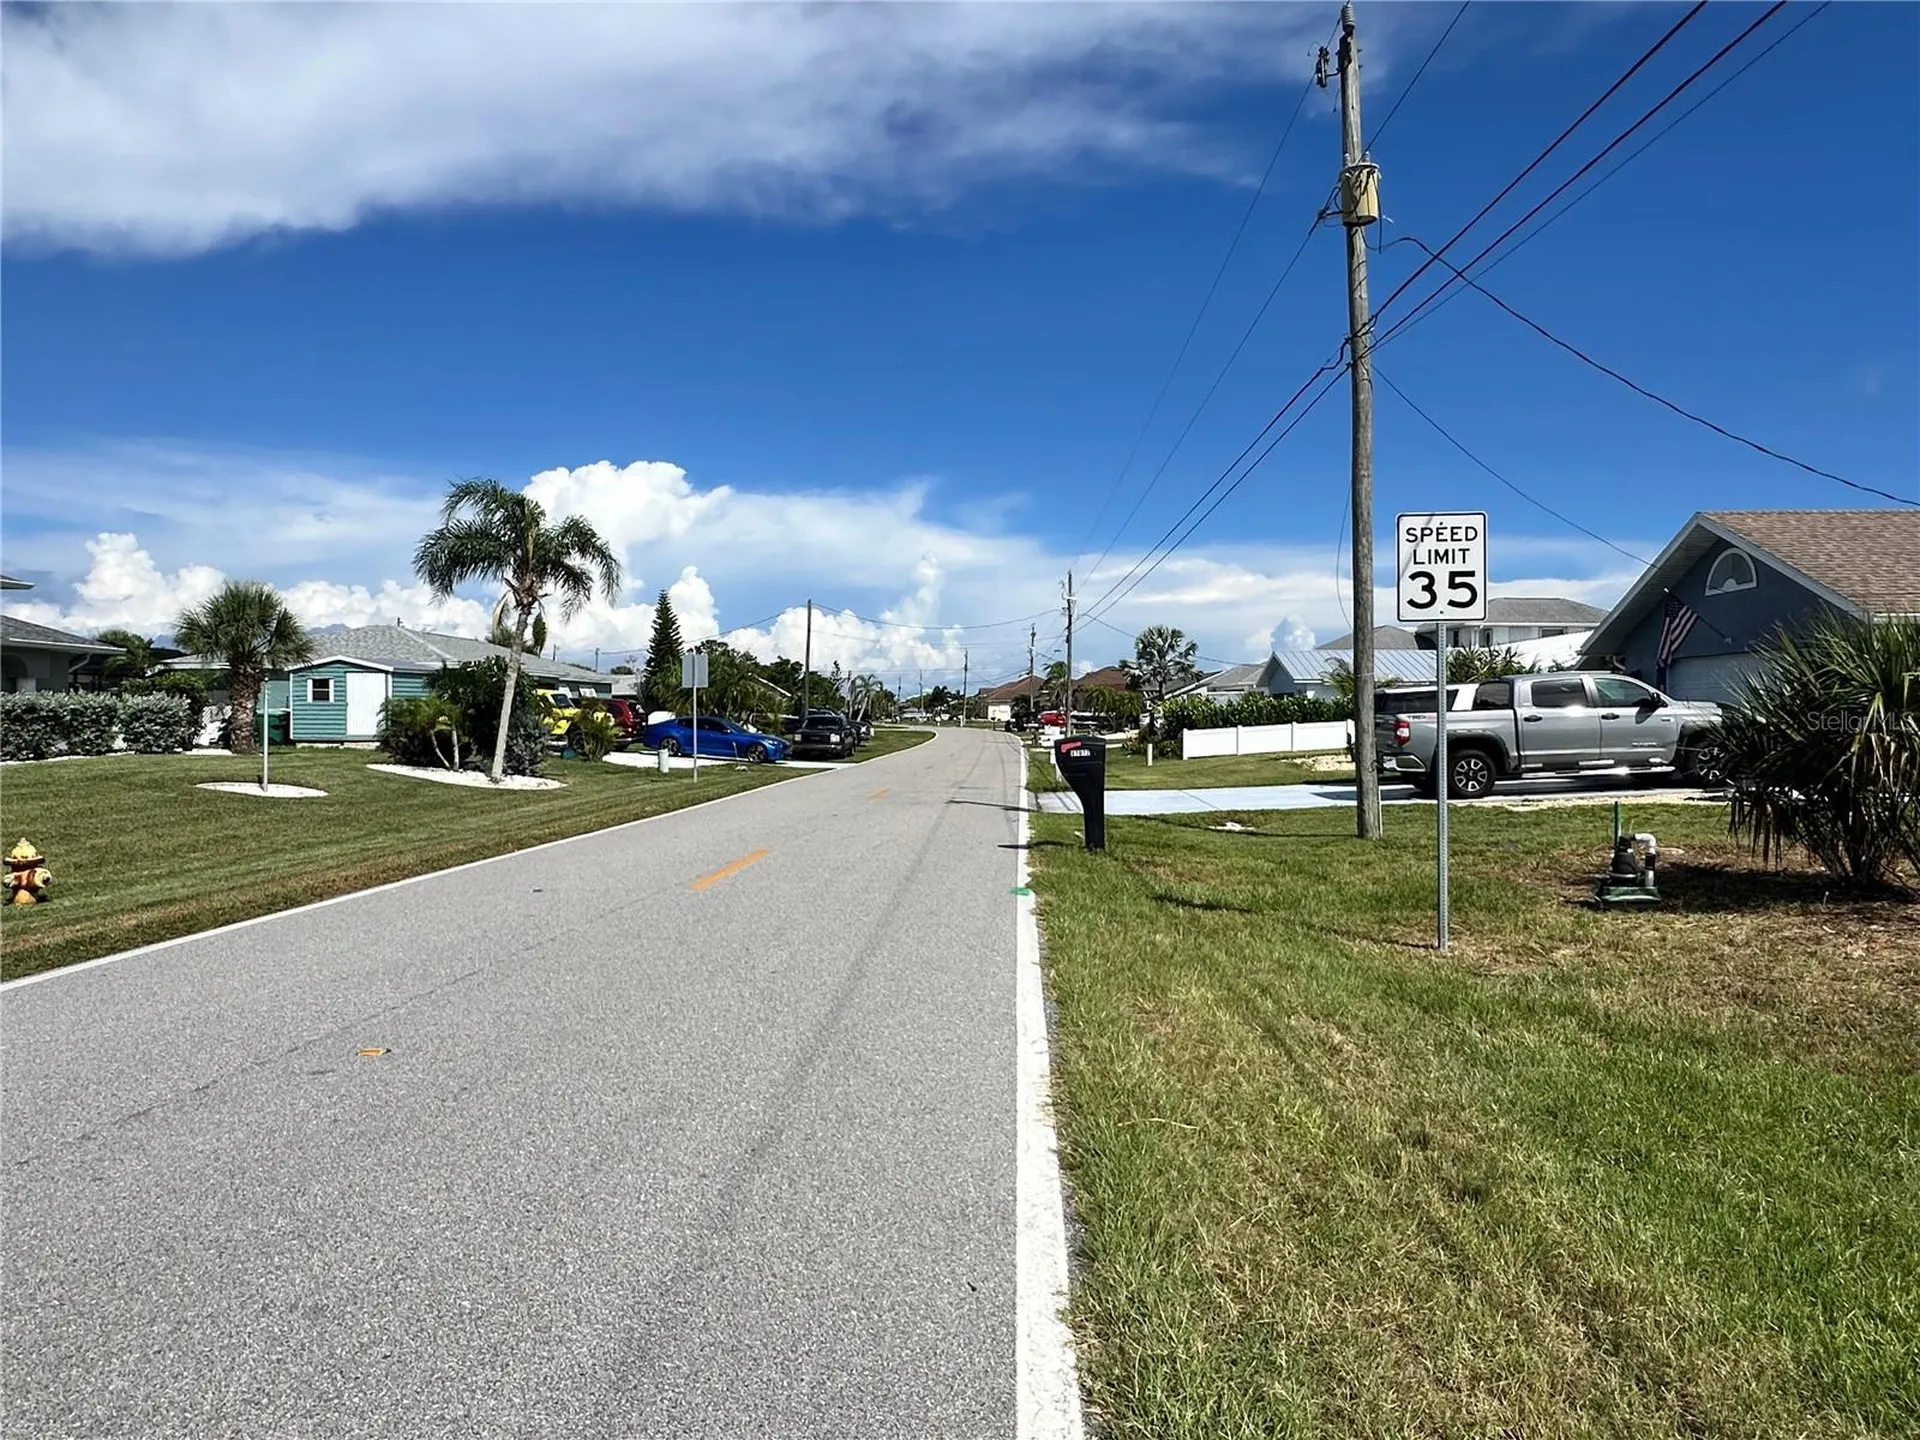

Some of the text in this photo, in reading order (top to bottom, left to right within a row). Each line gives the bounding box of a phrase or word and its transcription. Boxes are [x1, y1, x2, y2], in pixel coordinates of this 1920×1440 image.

[1406, 526, 1478, 543] SPEED
[1413, 548, 1470, 565] LIMIT
[1407, 570, 1477, 609] 35
